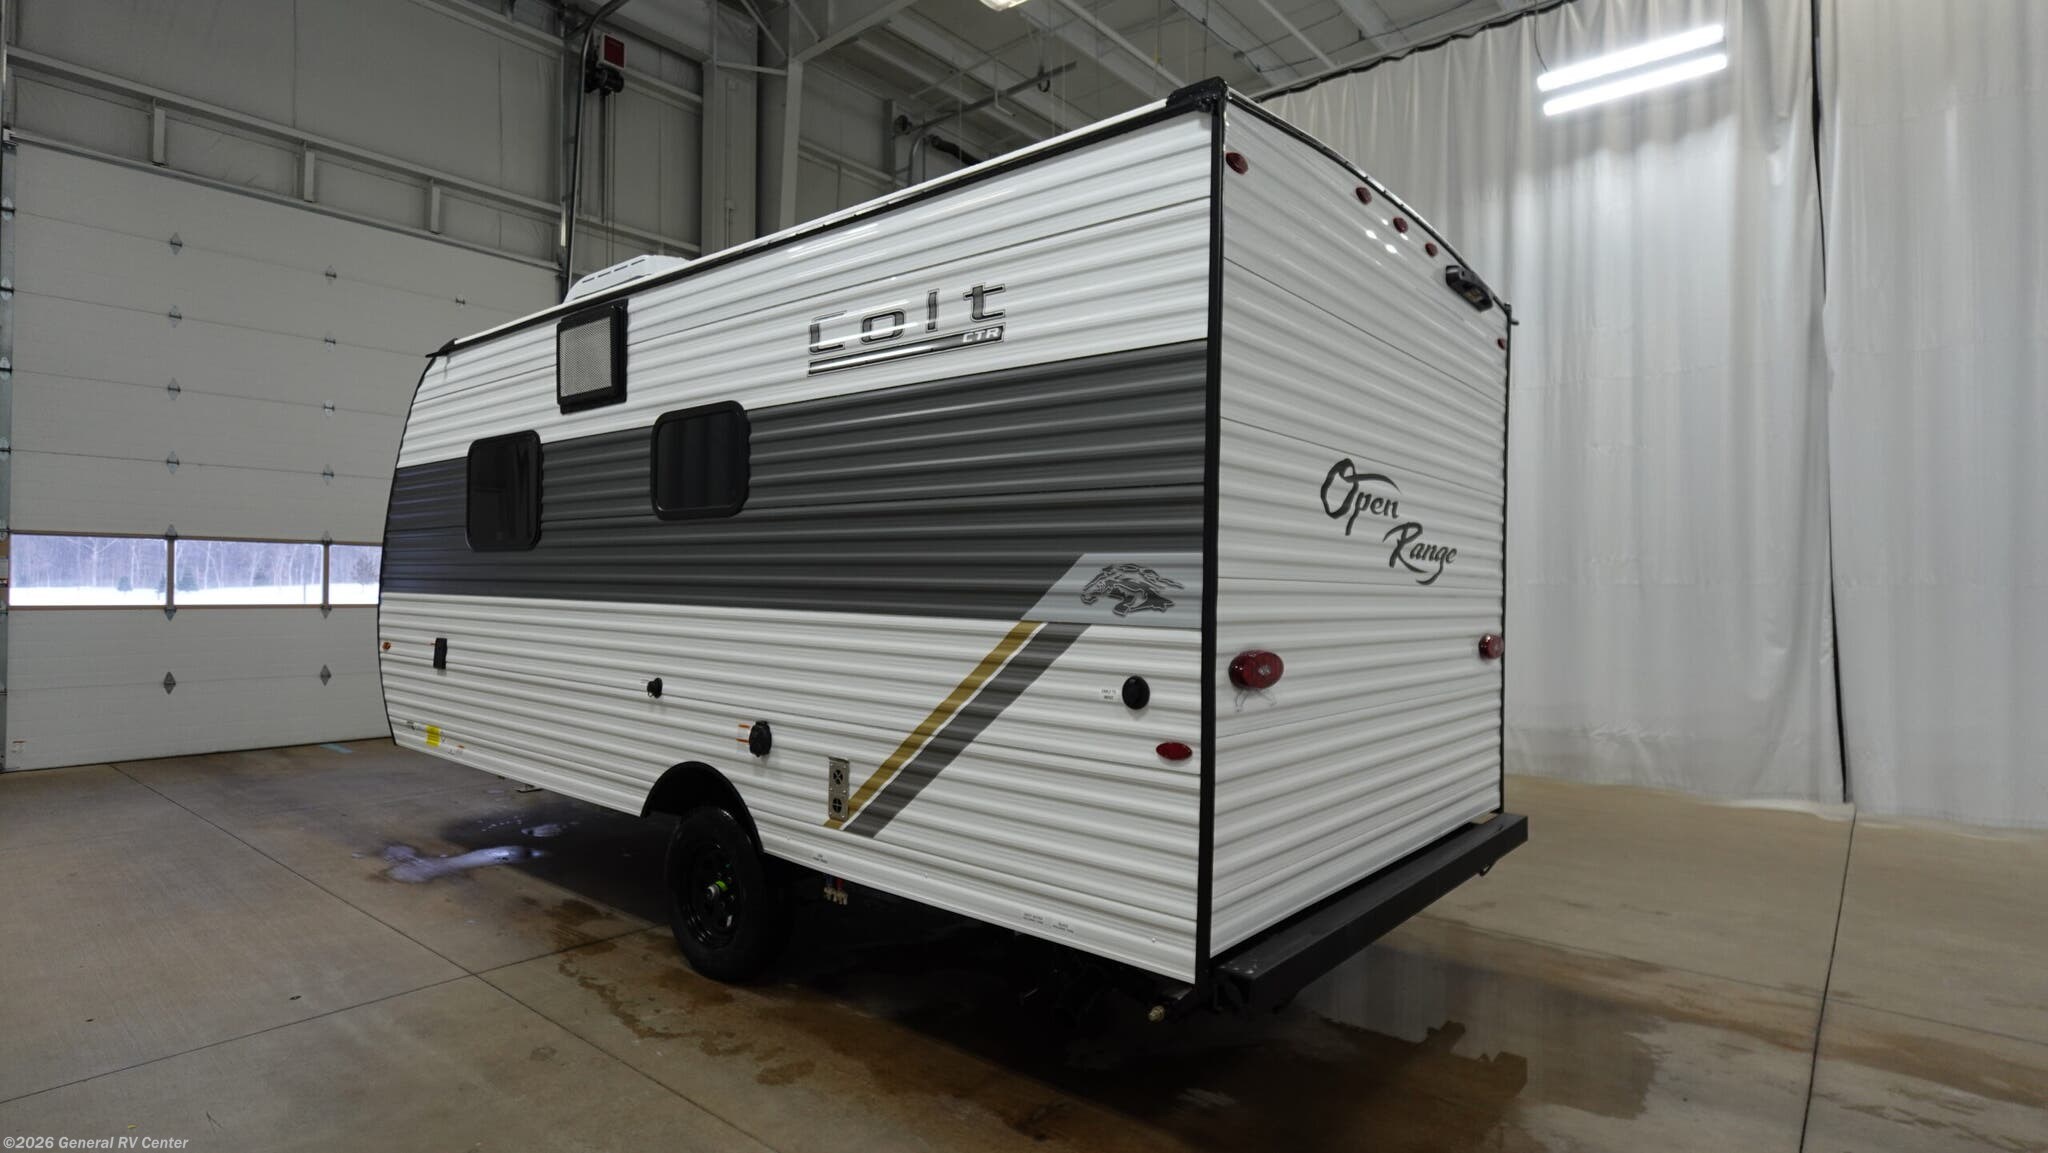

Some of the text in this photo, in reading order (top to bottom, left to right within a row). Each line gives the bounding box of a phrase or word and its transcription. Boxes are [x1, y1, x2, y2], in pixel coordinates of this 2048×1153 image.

[809, 283, 1006, 354] Colt
[962, 327, 1001, 343] CTR
[1320, 458, 1401, 536] Open
[1382, 521, 1457, 585] Range
